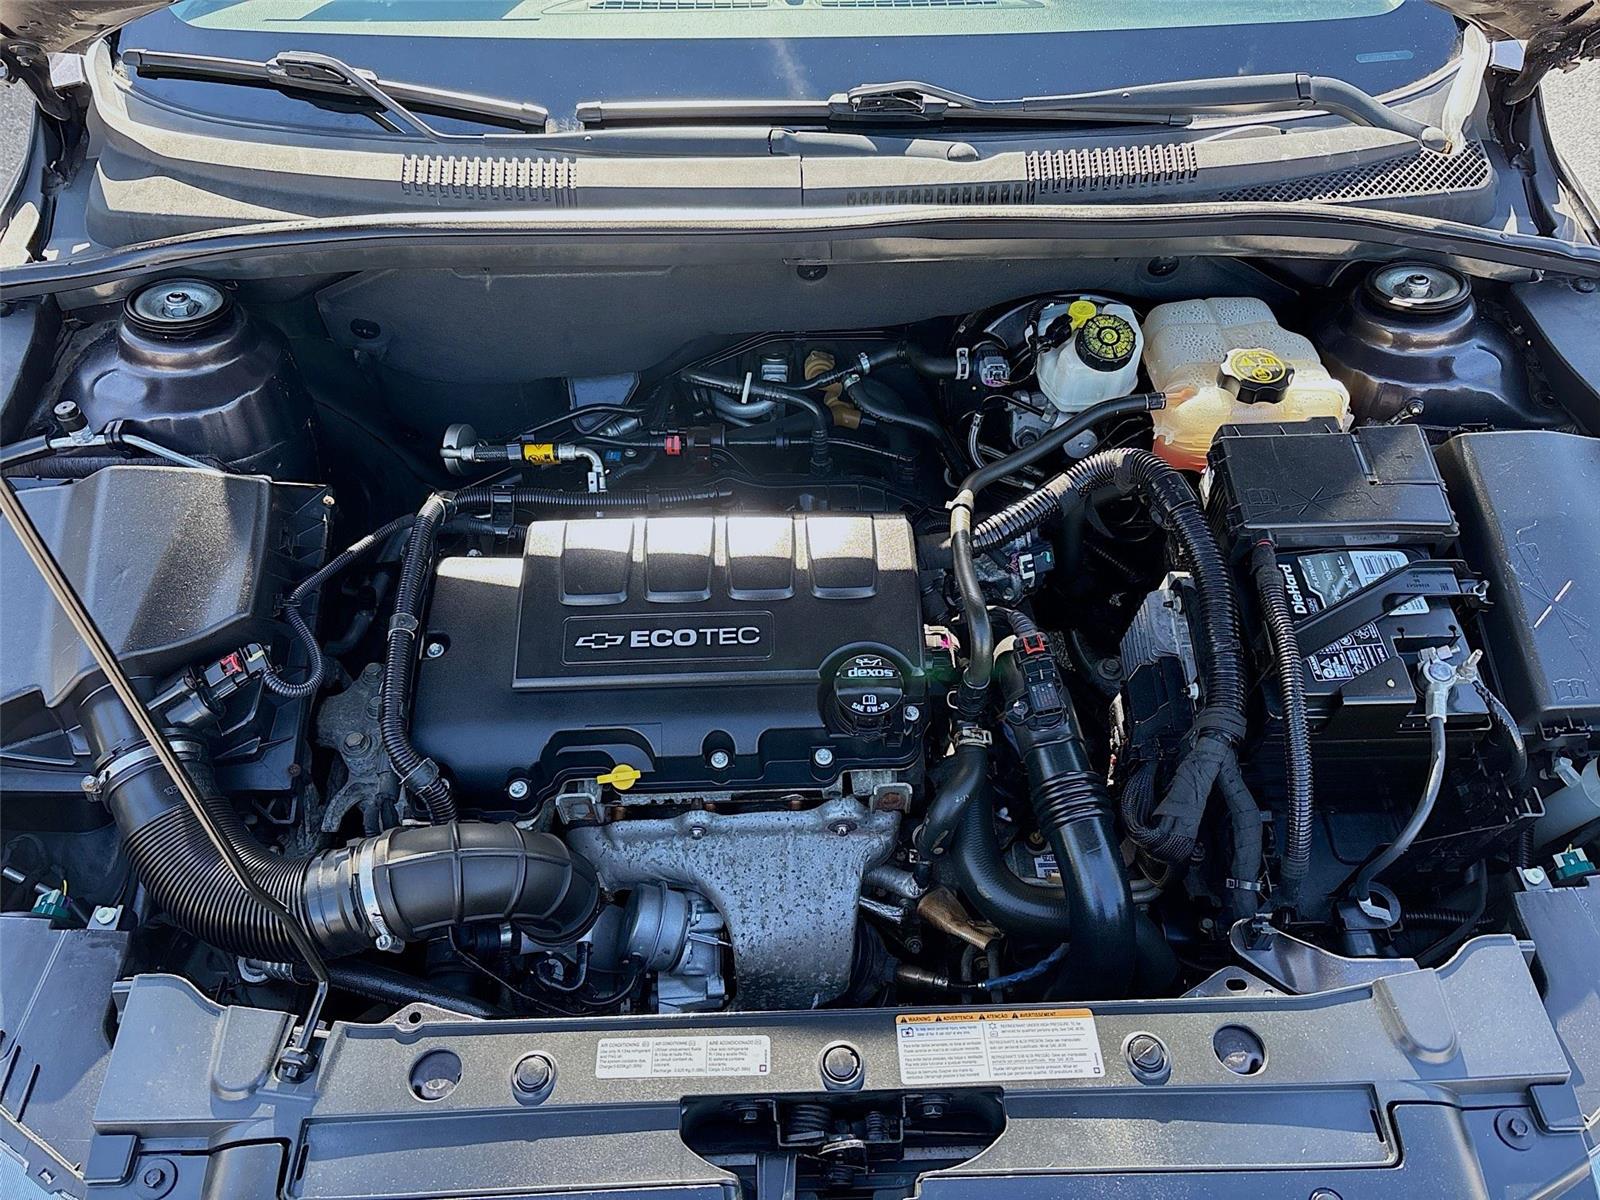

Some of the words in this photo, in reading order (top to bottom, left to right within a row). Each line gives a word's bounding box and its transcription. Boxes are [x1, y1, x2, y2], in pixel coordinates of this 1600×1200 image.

[1305, 558, 1321, 588] PLATINUM
[1278, 564, 1308, 614] DieHard
[630, 626, 761, 648] ECOTEC
[847, 667, 894, 677] dexos
[851, 702, 865, 712] SAE
[866, 701, 890, 713] 5W-30
